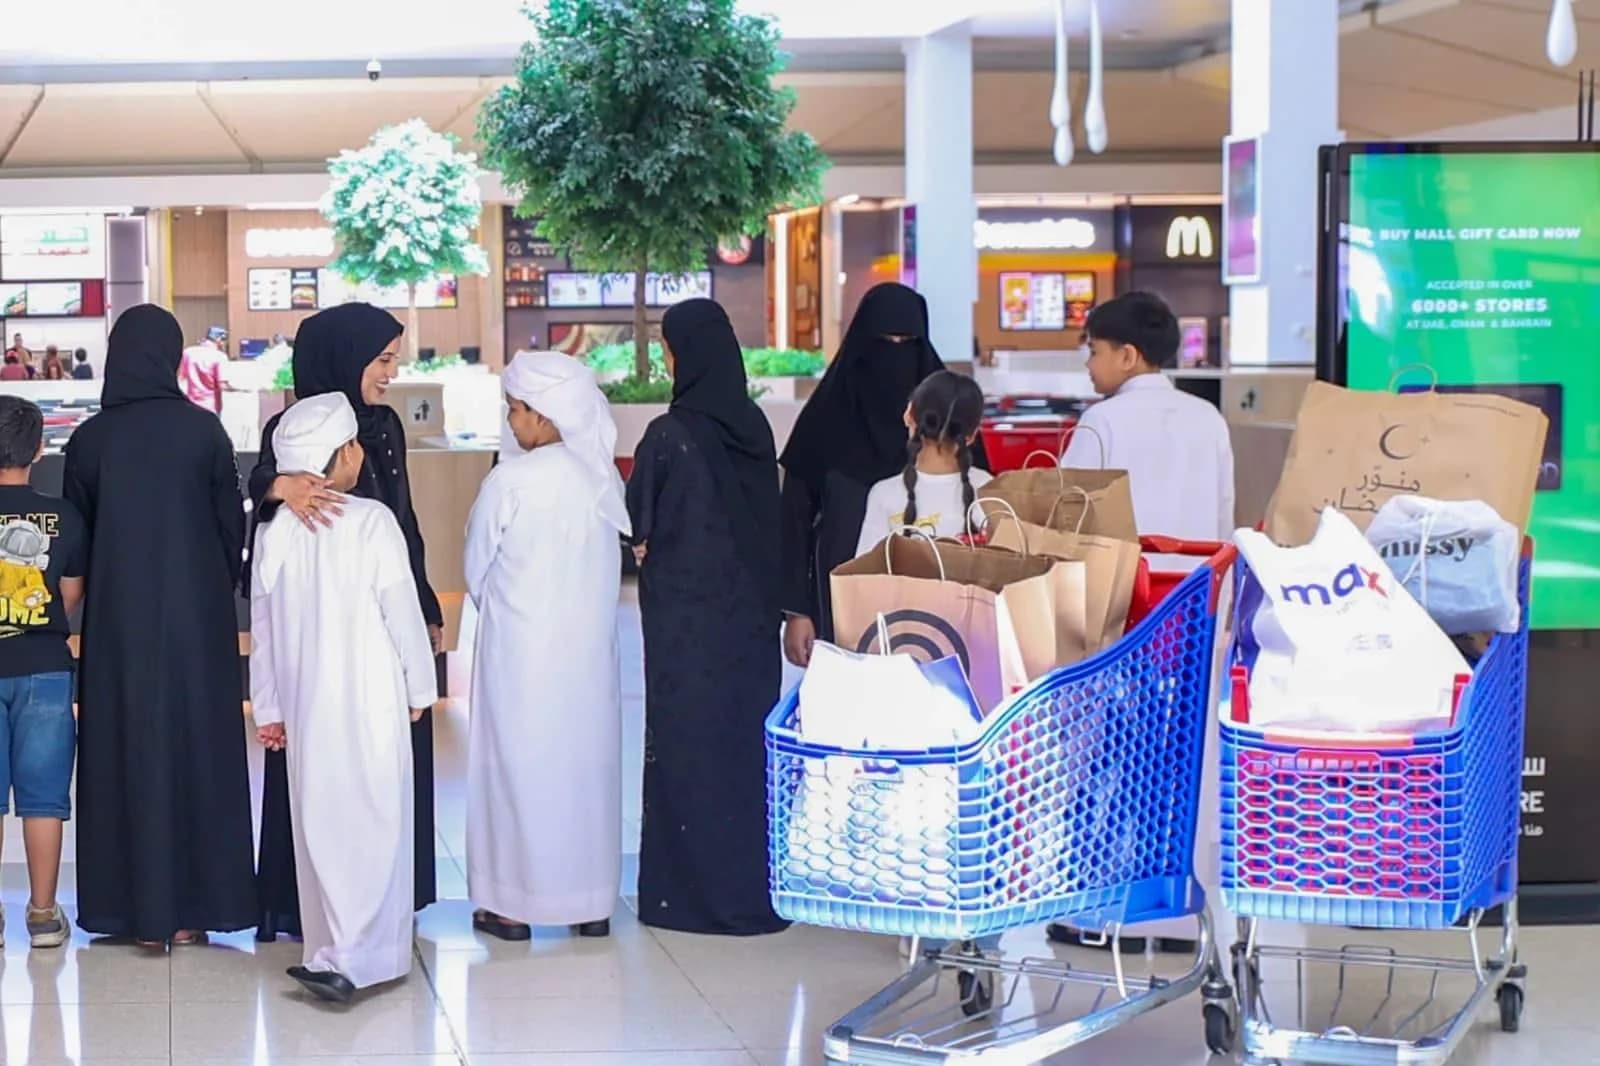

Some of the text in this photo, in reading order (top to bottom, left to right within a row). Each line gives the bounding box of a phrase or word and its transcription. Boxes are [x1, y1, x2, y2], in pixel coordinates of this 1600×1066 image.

[1380, 227, 1581, 240] BUY MALL GIFT CARD NOW
[1425, 280, 1533, 290] ACCEPTED IN OVER
[1411, 298, 1548, 313] 6000+ STORES
[1406, 319, 1420, 329] AT
[1279, 563, 1390, 606] max
[1519, 791, 1545, 813] RE
